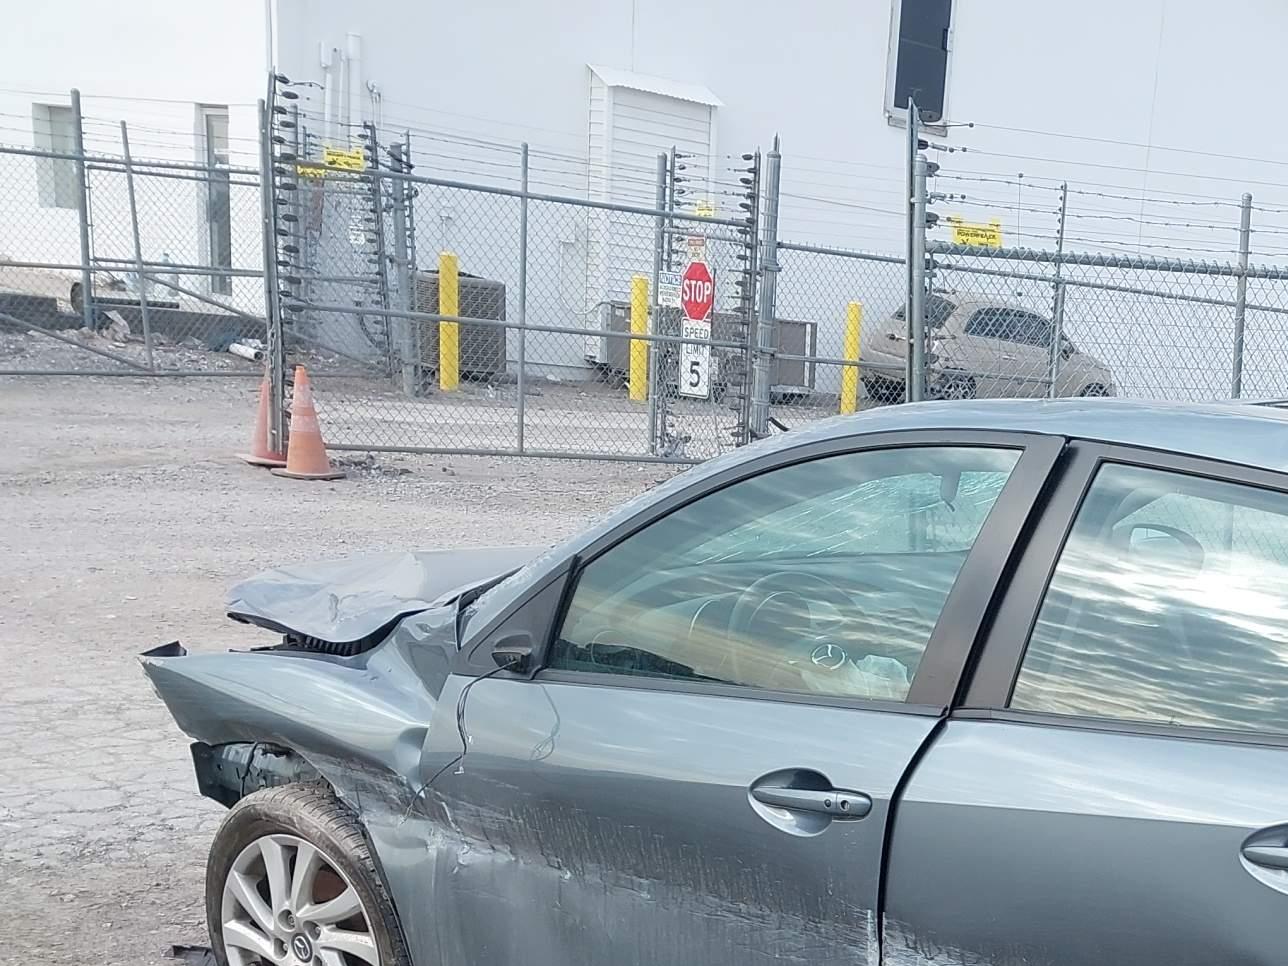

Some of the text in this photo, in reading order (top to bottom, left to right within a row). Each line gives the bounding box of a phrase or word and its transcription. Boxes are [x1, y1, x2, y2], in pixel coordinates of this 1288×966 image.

[683, 279, 712, 303] STOP
[684, 327, 709, 339] SPEED
[689, 361, 700, 387] 5
